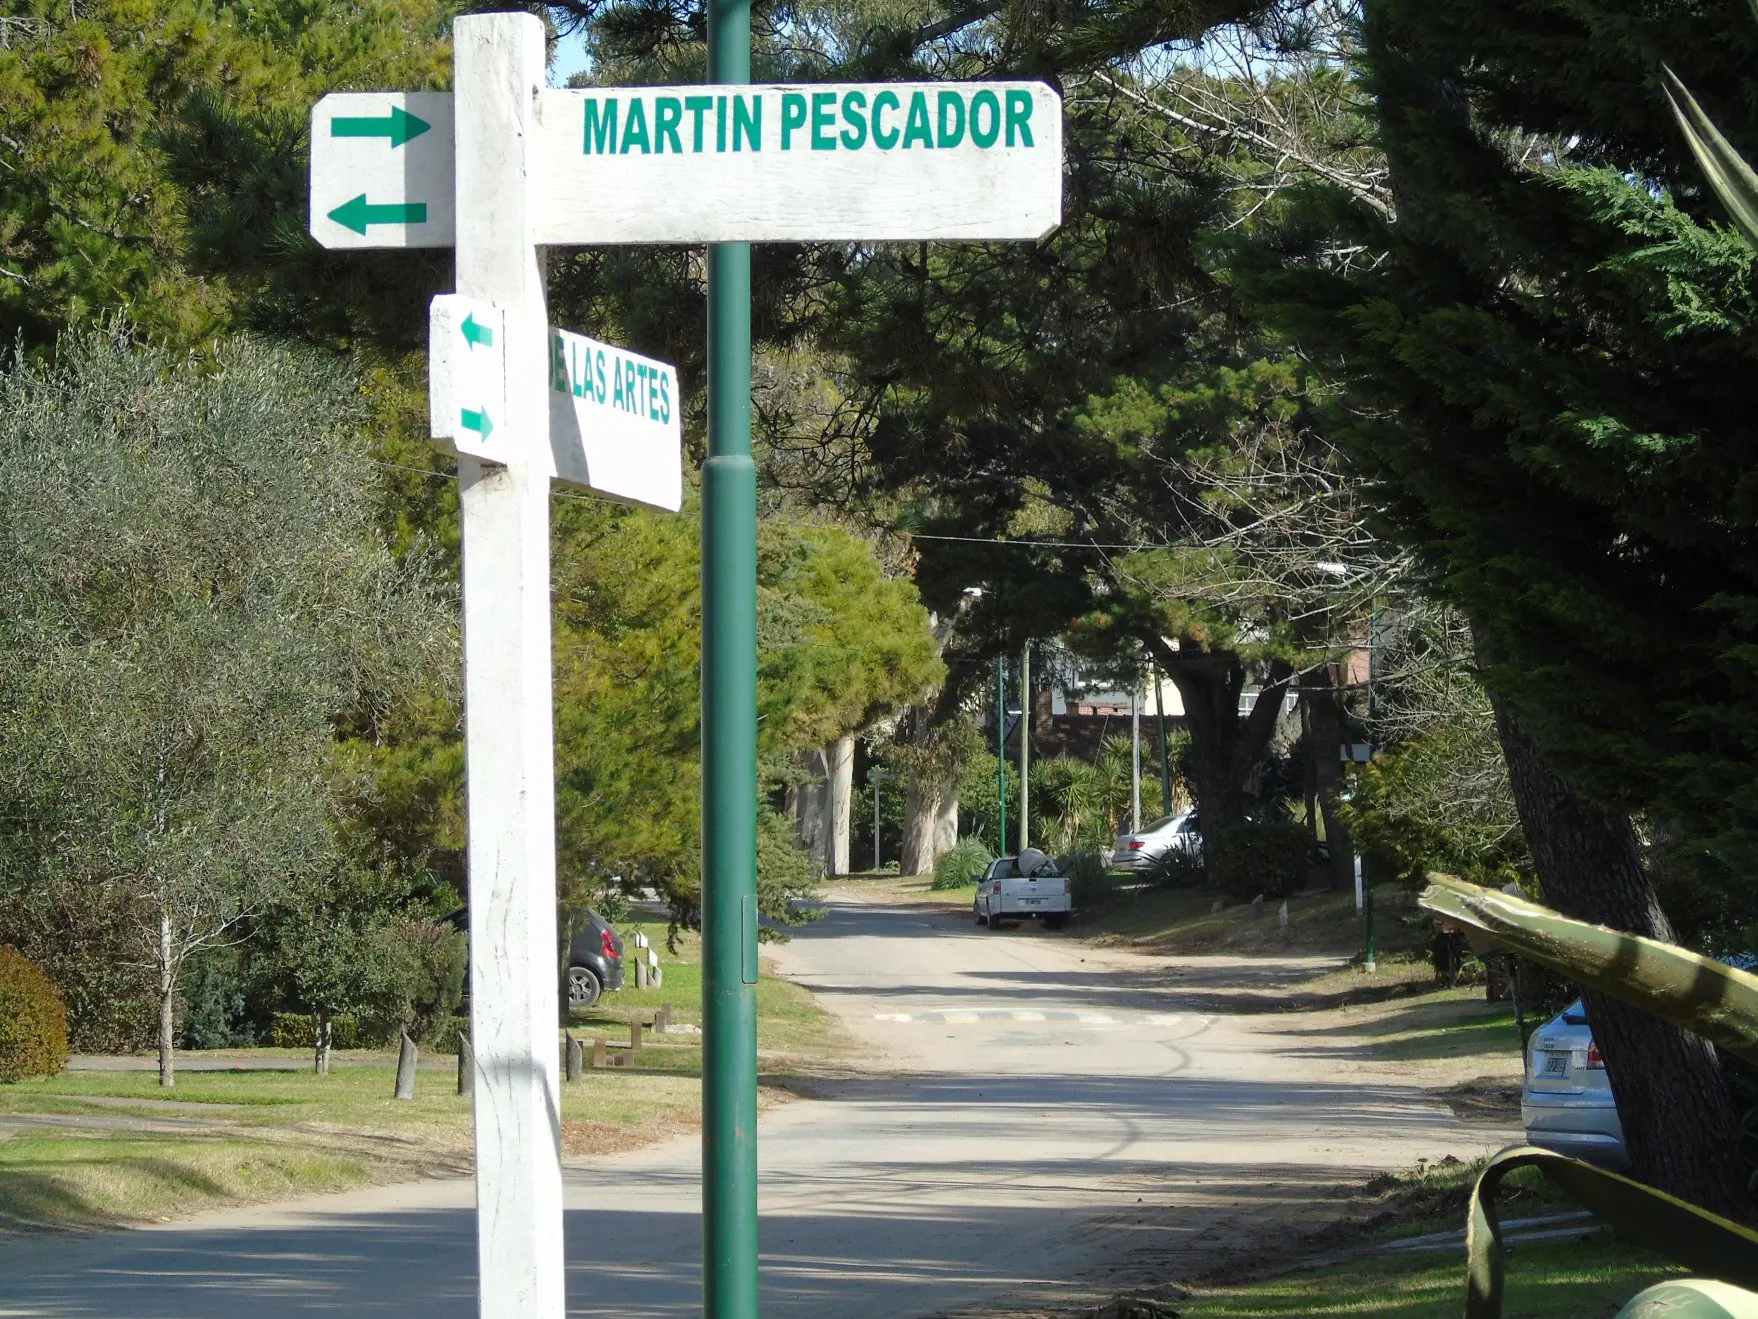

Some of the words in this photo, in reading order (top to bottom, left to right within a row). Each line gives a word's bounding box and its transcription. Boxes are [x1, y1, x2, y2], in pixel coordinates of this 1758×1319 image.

[583, 94, 762, 155] MARTIN
[780, 89, 1035, 151] PESCADOR
[572, 341, 607, 405] LAS
[612, 355, 670, 425] ARTES
